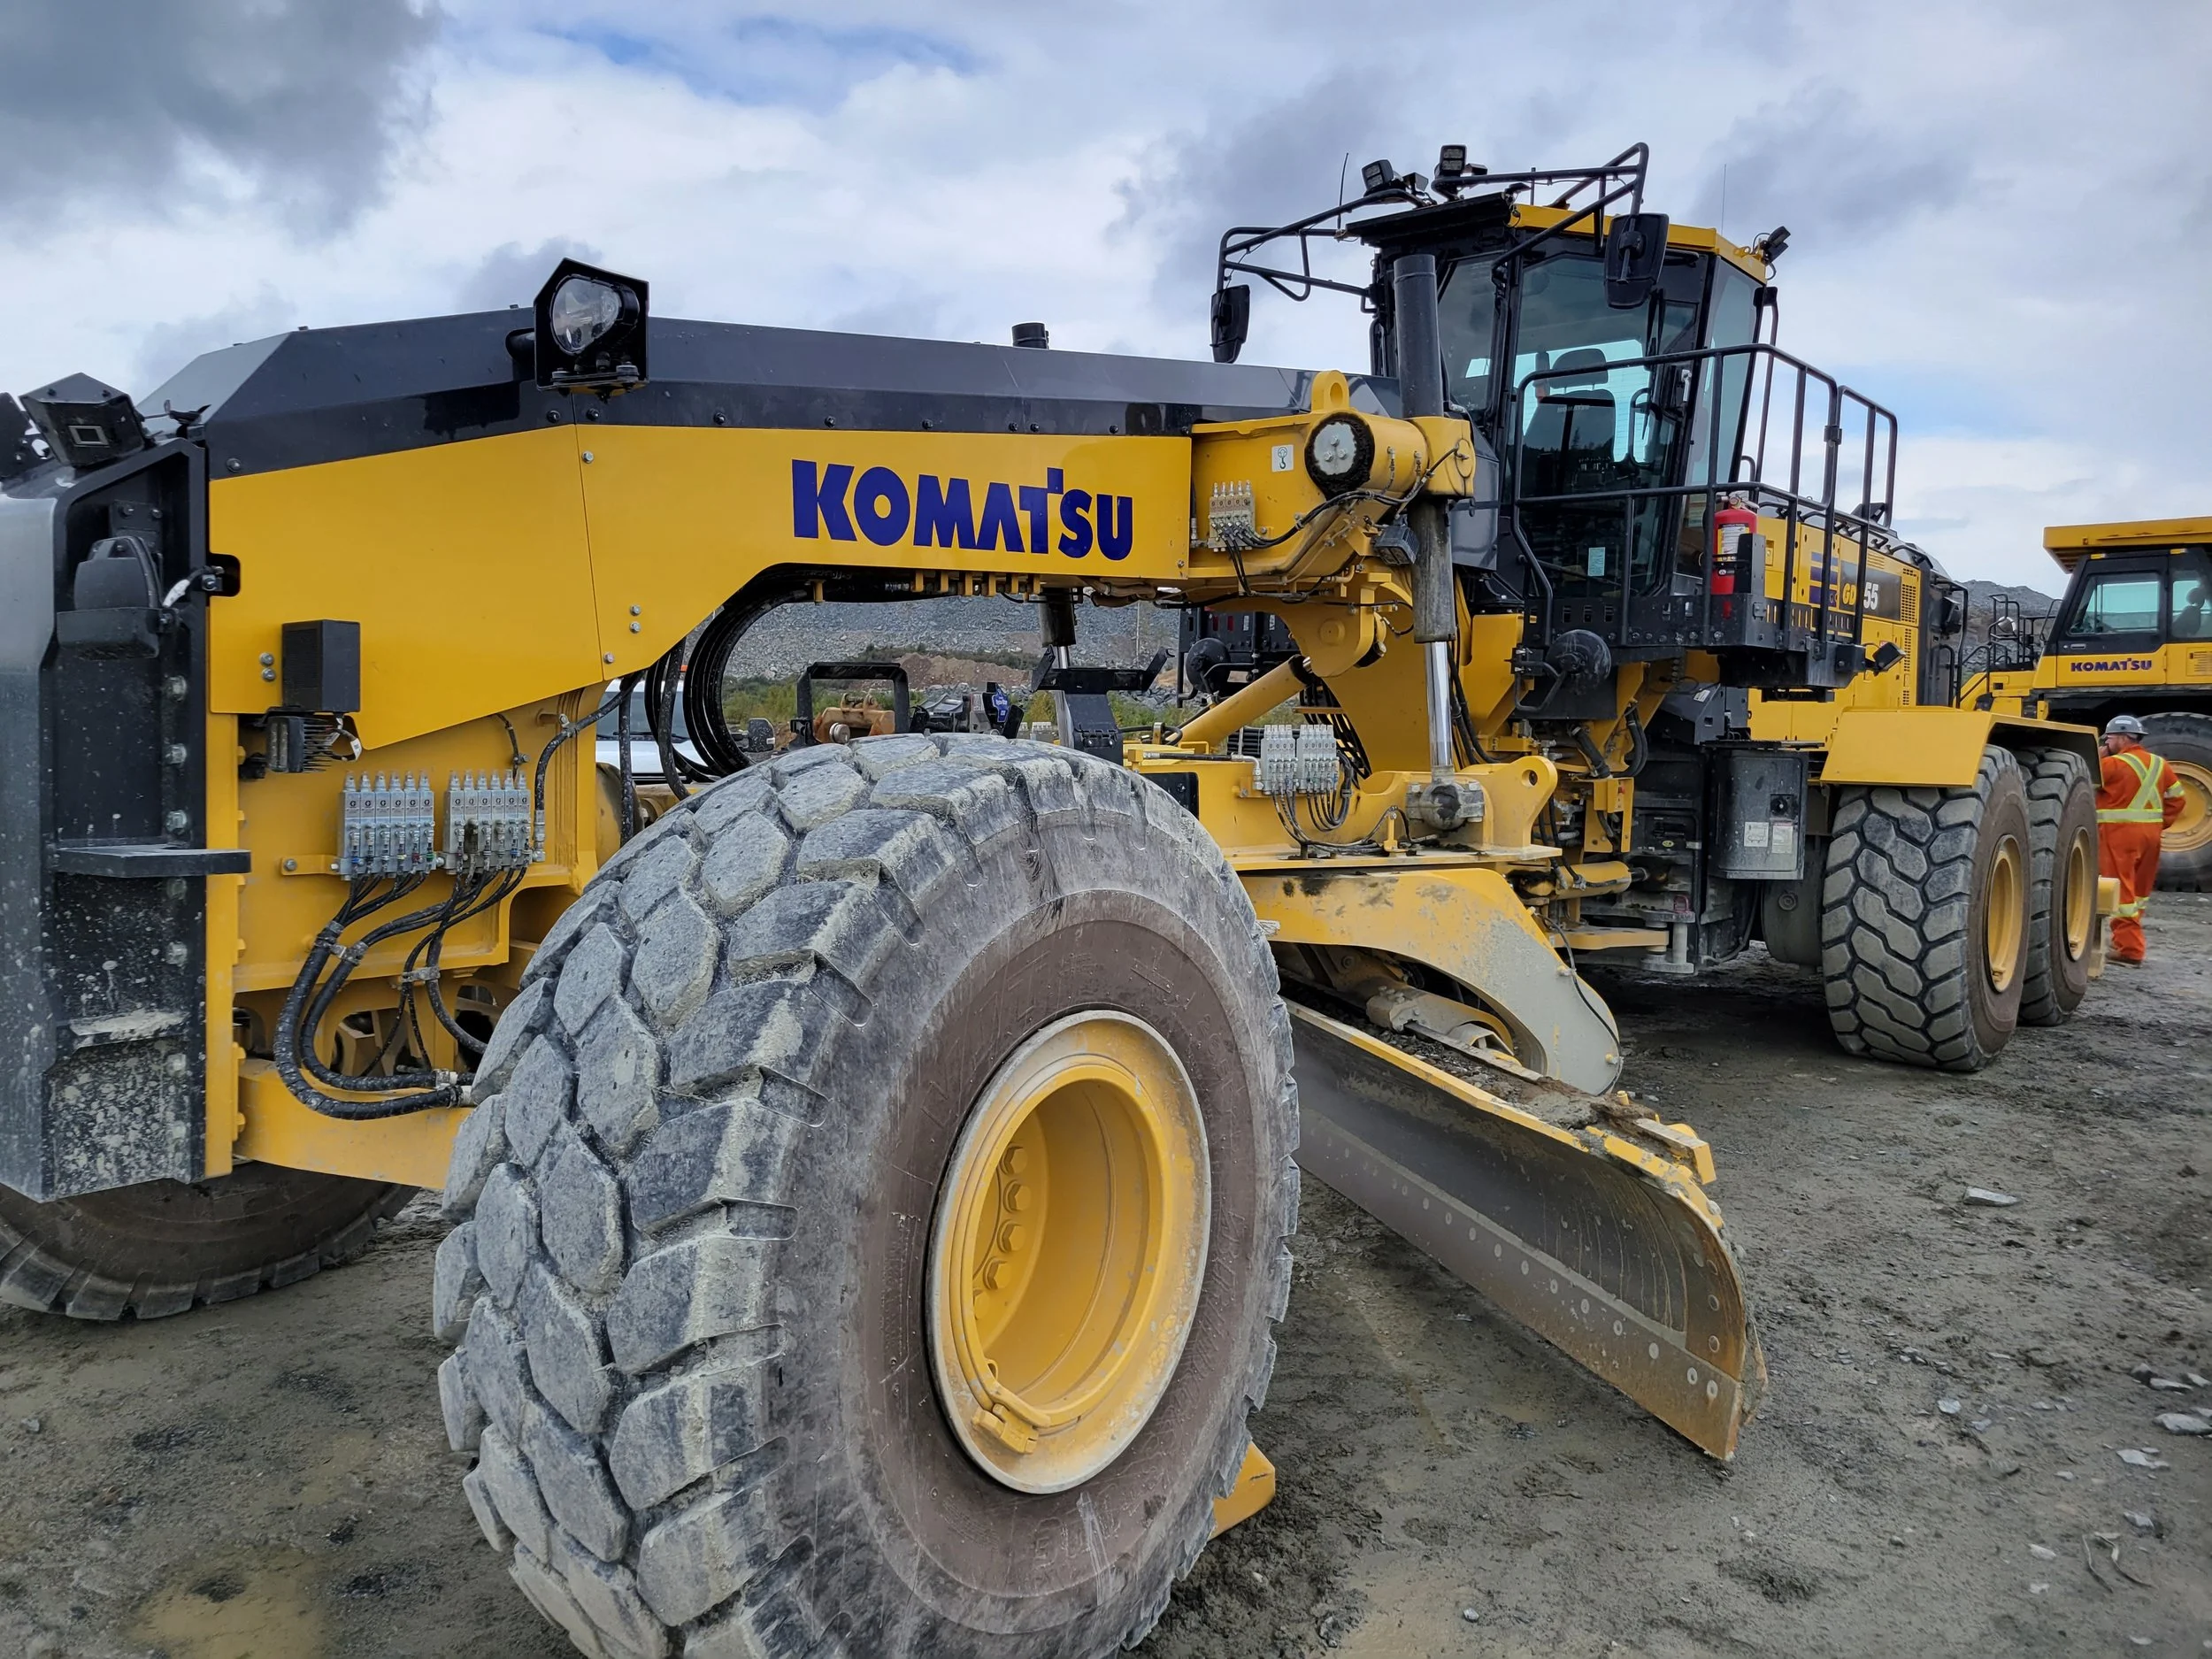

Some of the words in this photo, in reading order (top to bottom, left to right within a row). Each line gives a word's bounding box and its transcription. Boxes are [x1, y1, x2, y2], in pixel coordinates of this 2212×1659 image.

[792, 458, 1133, 561] KOMATSU
[1842, 581, 1879, 611] GD55
[2070, 657, 2152, 672] KOMATSU
